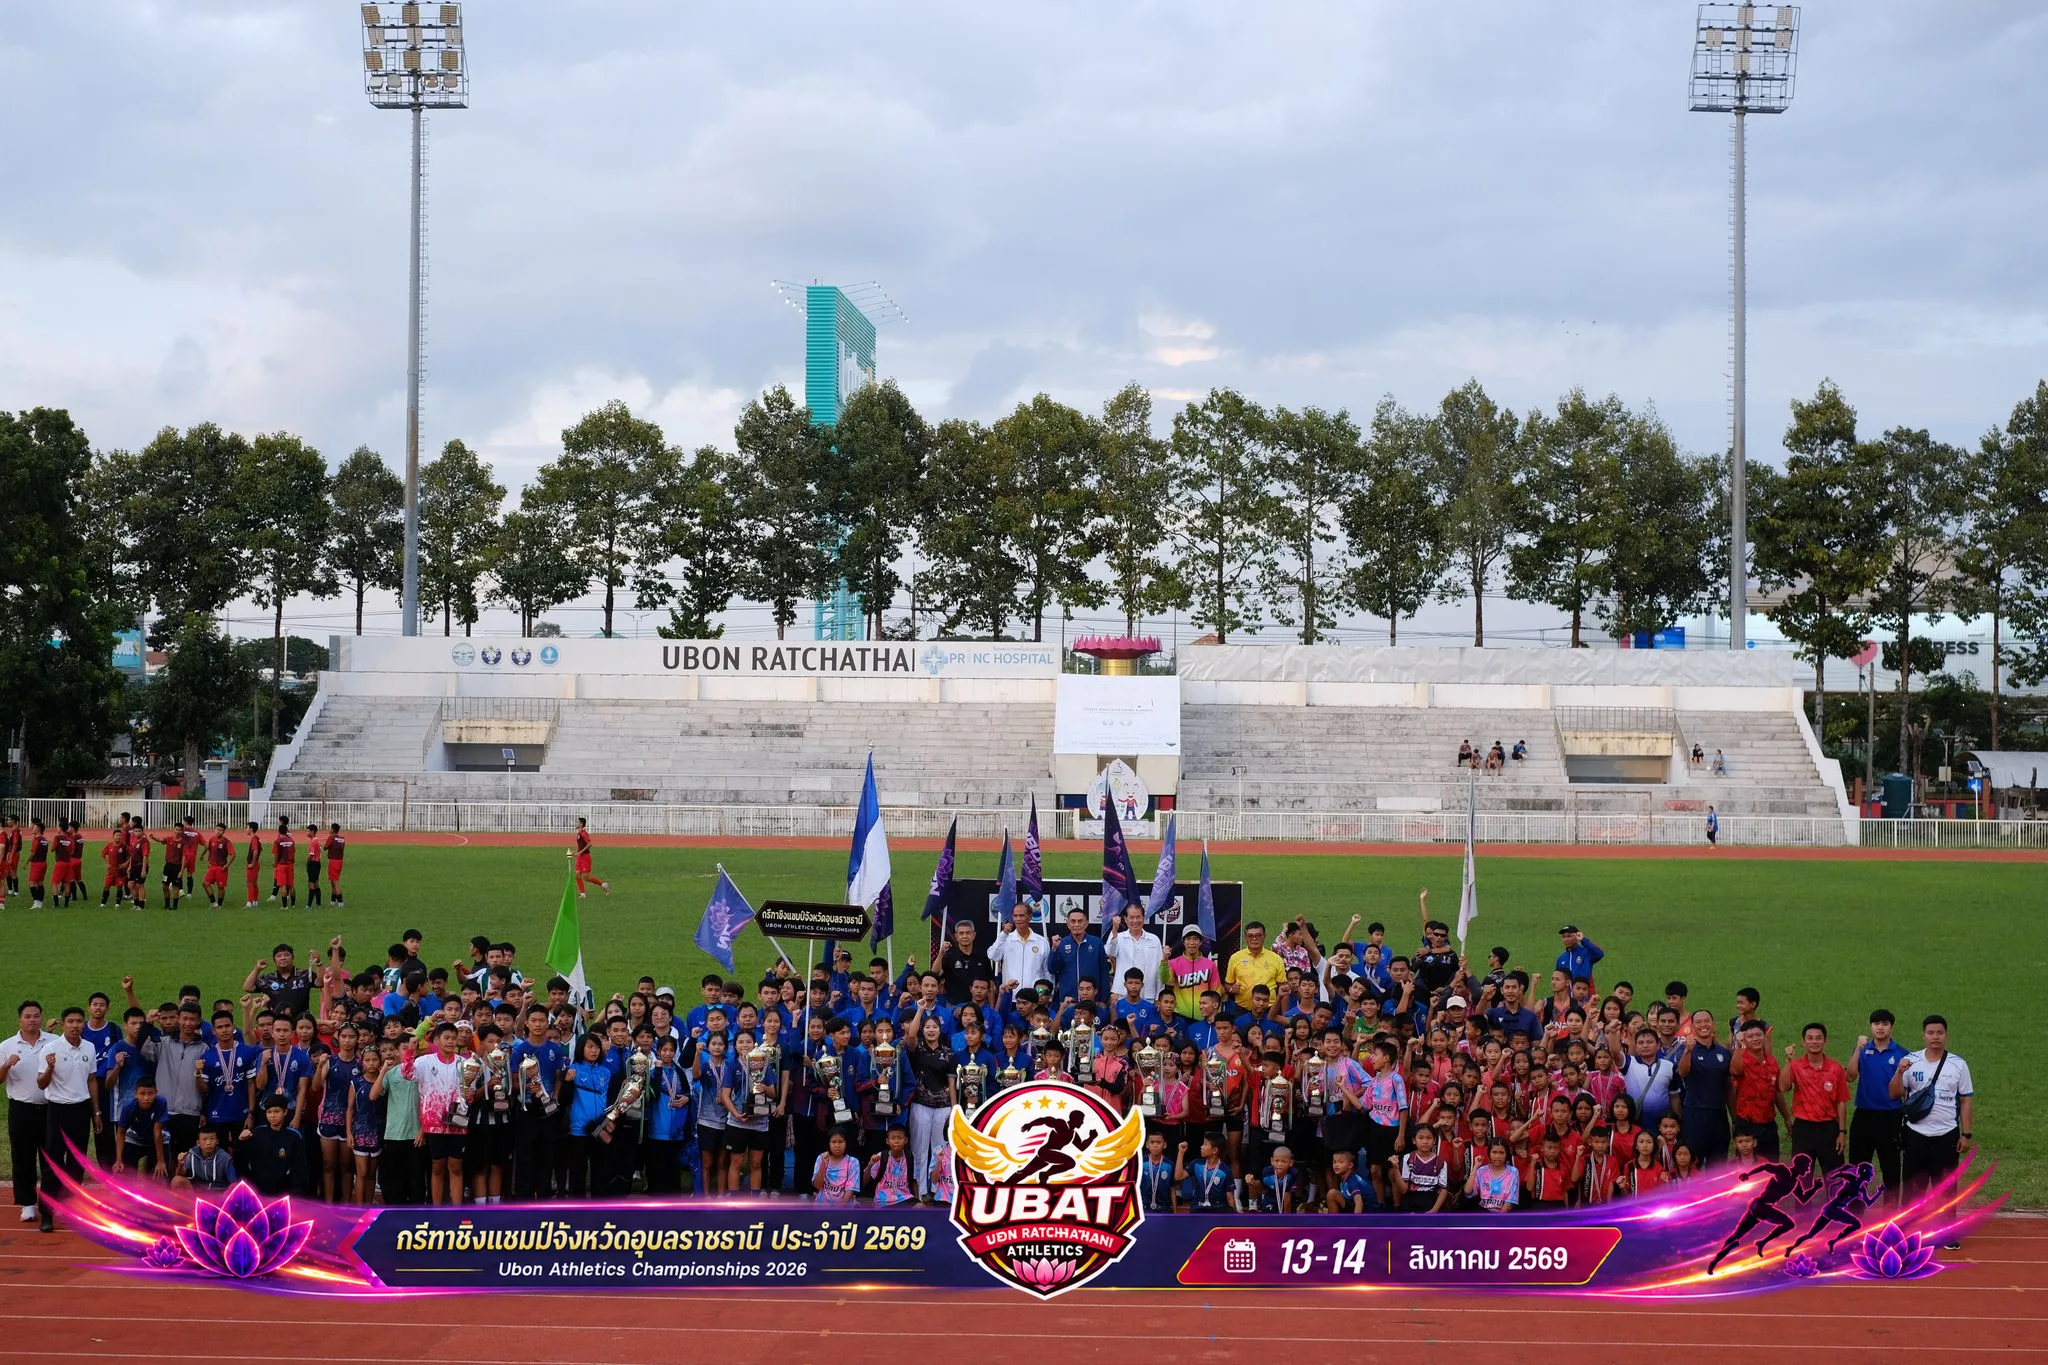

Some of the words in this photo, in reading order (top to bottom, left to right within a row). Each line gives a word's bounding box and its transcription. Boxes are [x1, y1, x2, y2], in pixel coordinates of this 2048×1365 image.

[662, 646, 740, 671] UBON
[993, 653, 1054, 665] HOSPITAL
[783, 923, 815, 931] ATHLETICS
[816, 925, 860, 933] CHAMPIONSHIPS
[1177, 969, 1210, 989] UBN
